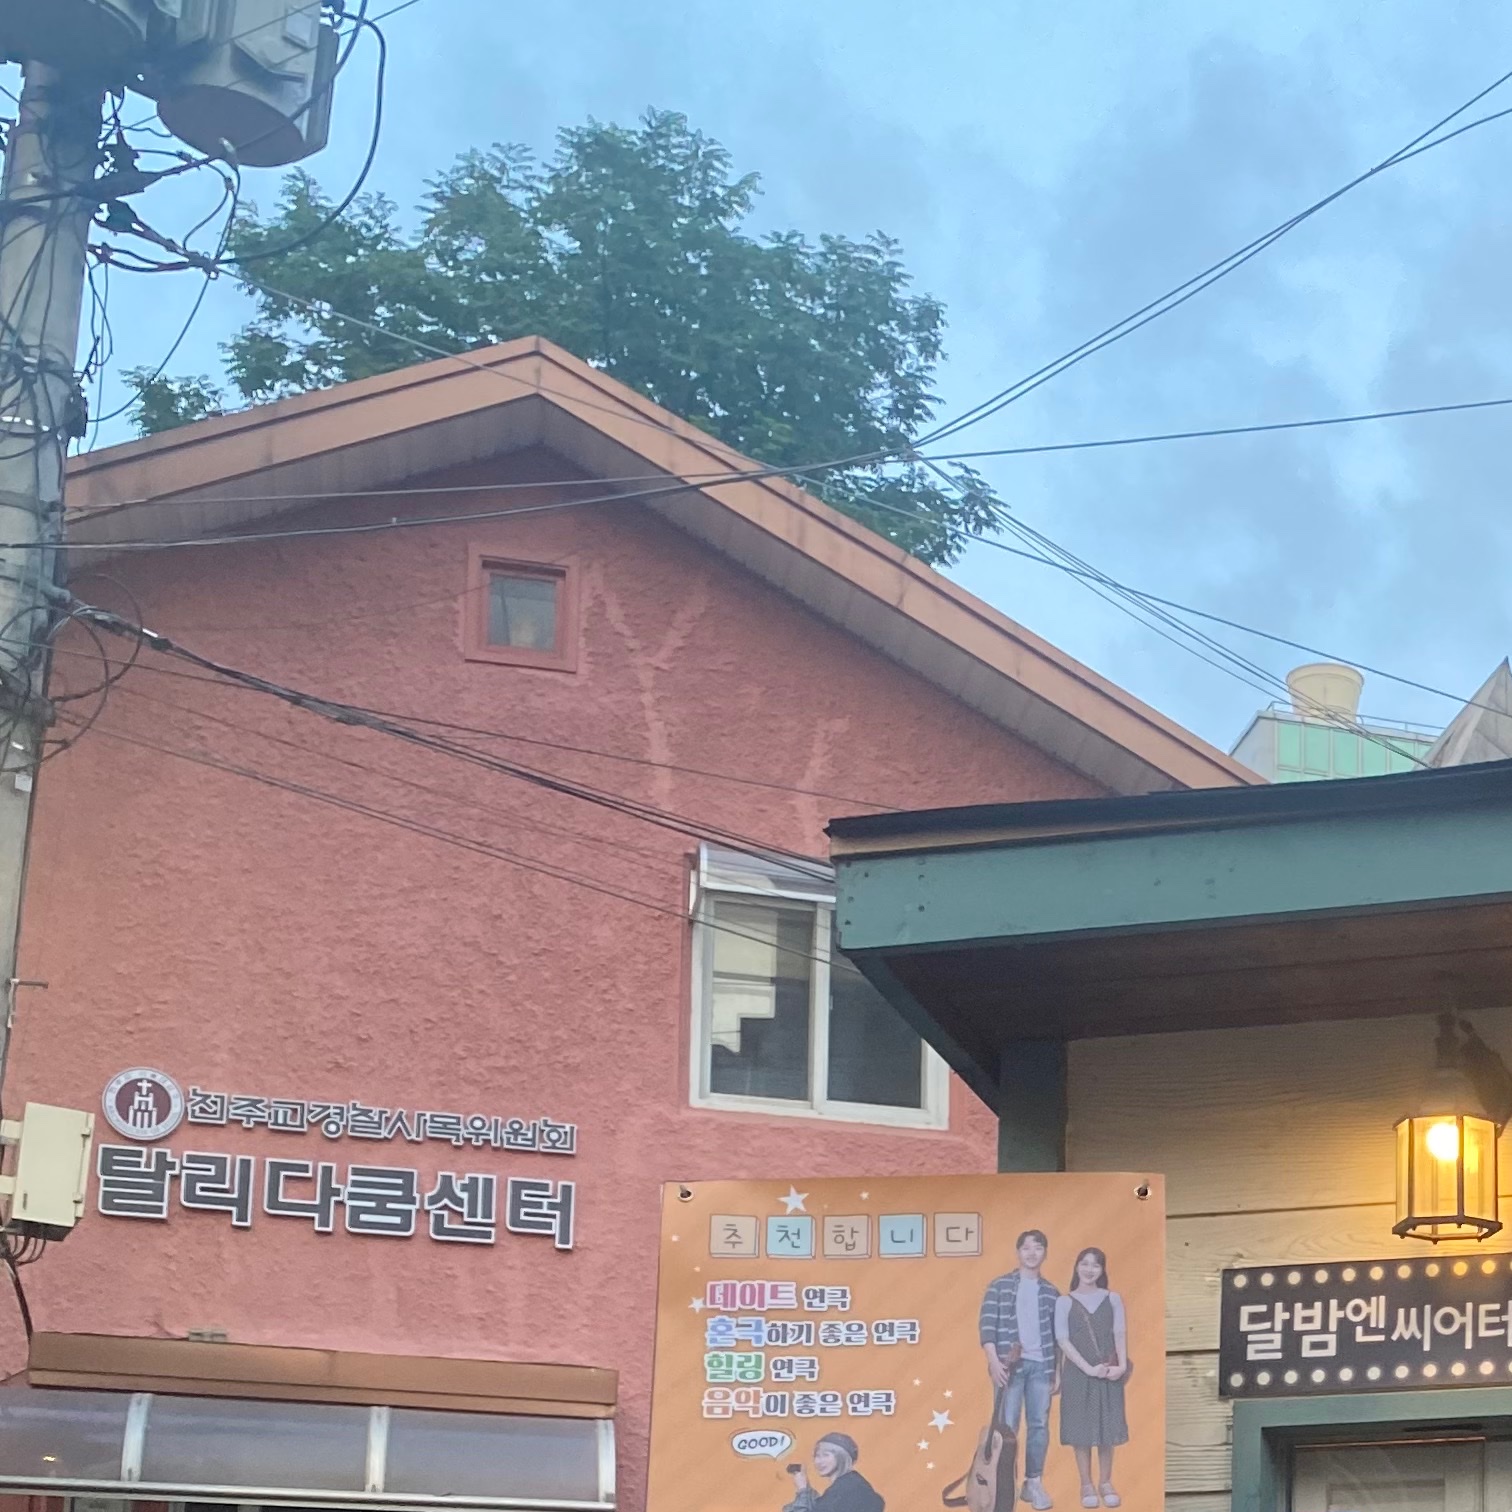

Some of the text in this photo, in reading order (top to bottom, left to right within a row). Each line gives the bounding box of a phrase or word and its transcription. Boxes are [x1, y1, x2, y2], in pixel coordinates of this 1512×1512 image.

[97, 1143, 577, 1251] 탈리다쿰센터
[722, 1223, 975, 1252] 추천합니다
[706, 1280, 851, 1312] 데이트 연극
[707, 1316, 920, 1348] 혼극하기 좋은 연극
[705, 1351, 819, 1383] 힐링 연극
[702, 1387, 896, 1418] 음악이 좋은 연극
[737, 1434, 786, 1451] GOOD!
